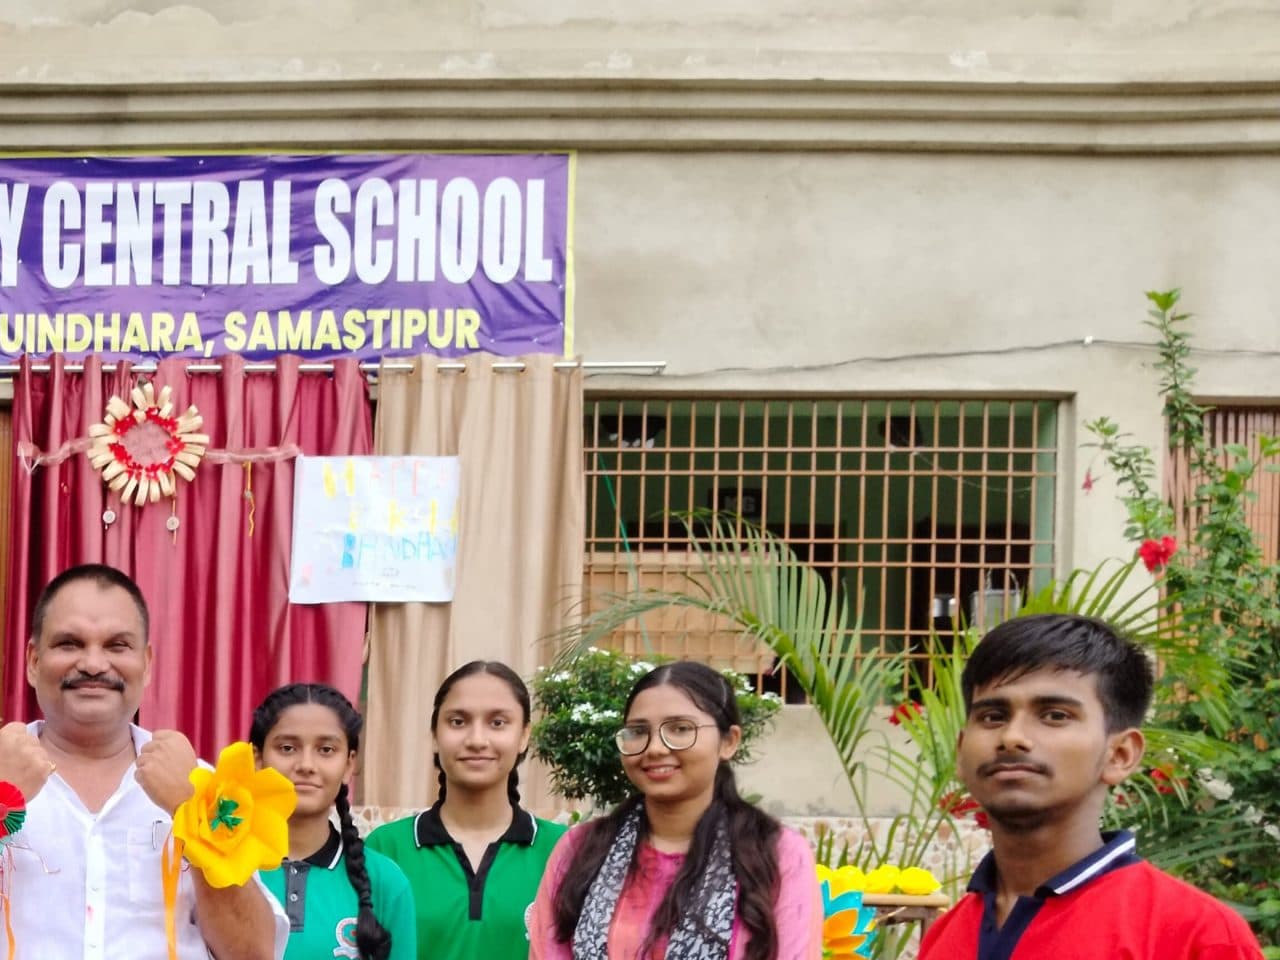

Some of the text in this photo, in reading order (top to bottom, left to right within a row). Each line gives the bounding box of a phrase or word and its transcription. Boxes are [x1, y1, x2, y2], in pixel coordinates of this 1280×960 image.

[43, 181, 299, 289] CENTRAL
[313, 177, 553, 285] SCHOOL
[224, 308, 481, 351] SAMASTIPUR
